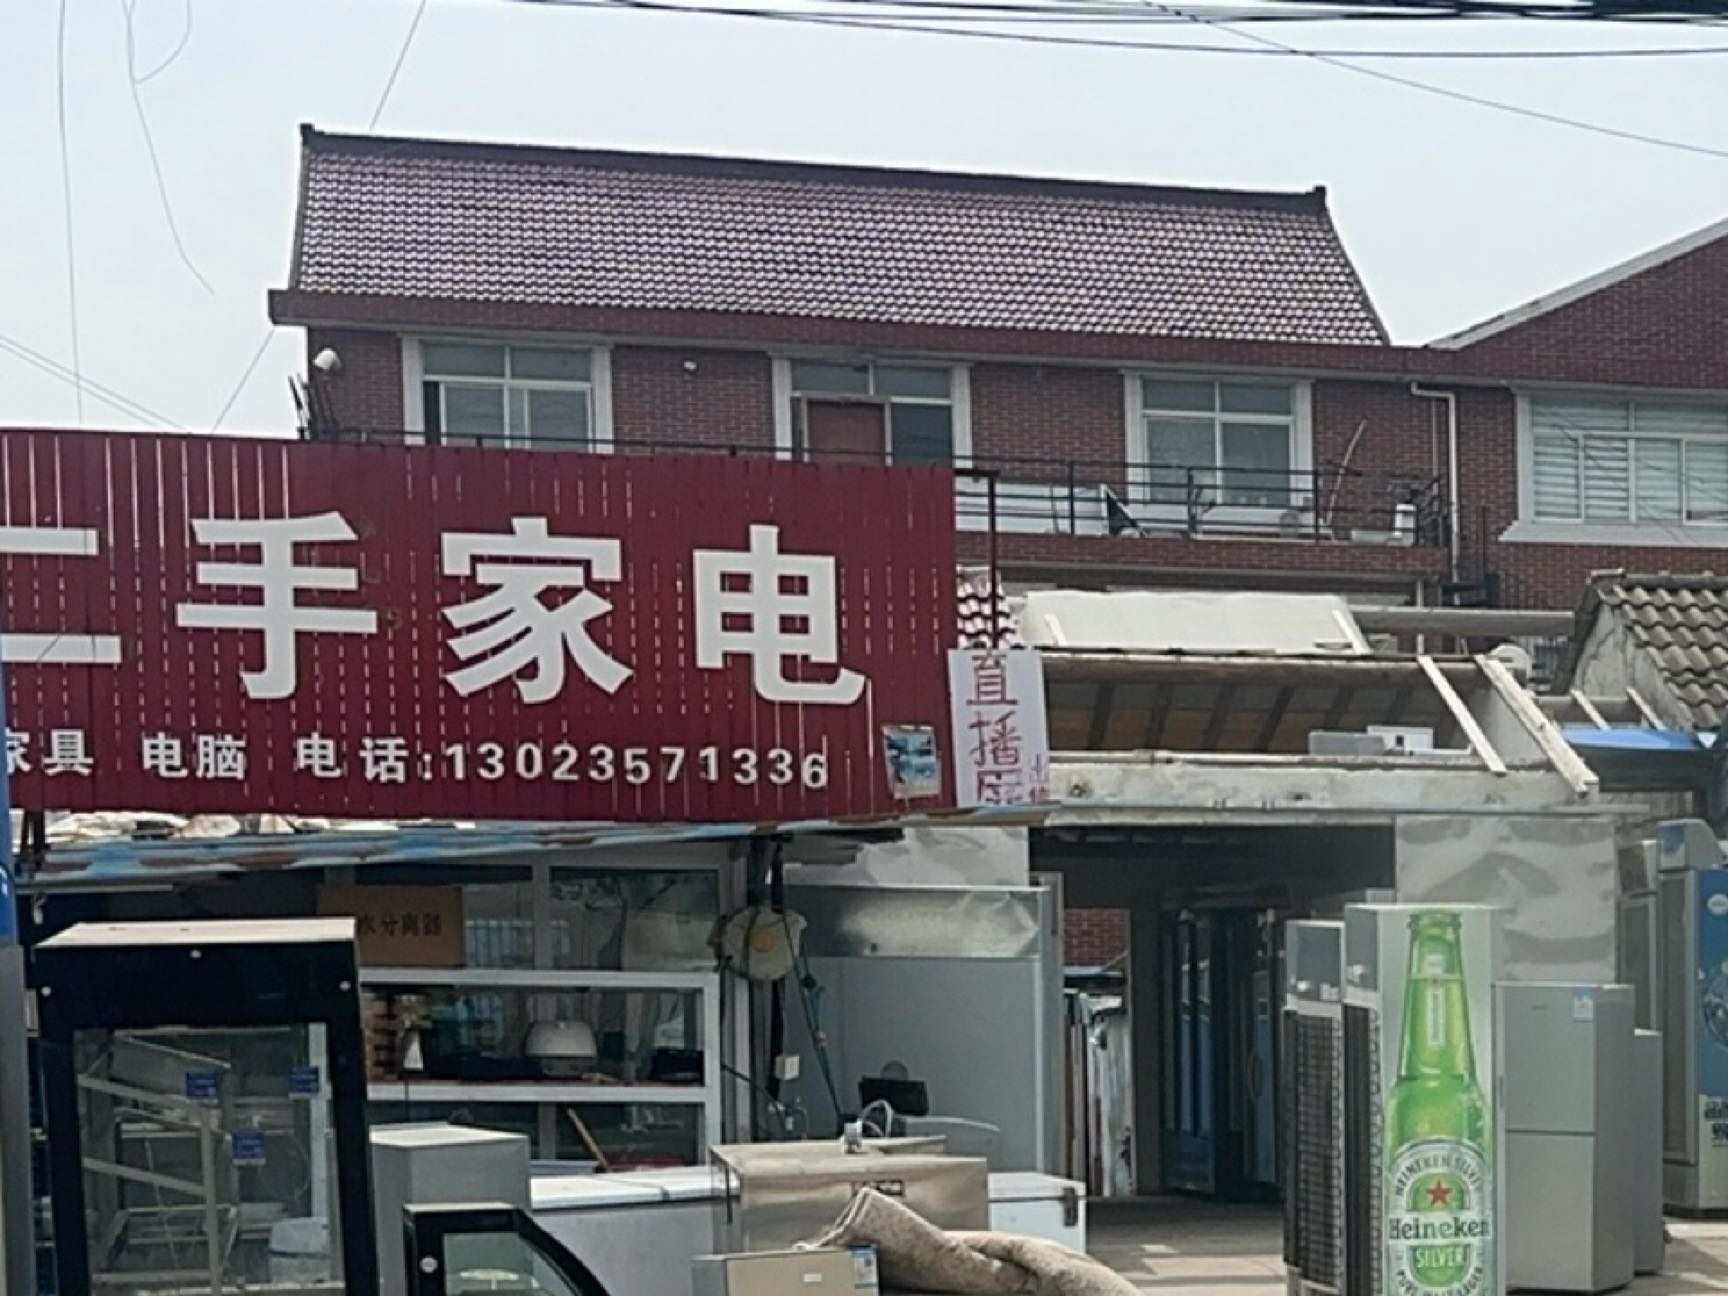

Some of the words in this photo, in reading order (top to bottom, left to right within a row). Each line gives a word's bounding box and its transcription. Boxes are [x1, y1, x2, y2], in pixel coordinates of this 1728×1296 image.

[0, 511, 867, 705] 二手家电
[142, 732, 247, 780] 电脑
[1388, 1216, 1490, 1240] Heineken
[1415, 1247, 1466, 1269] SILVER
